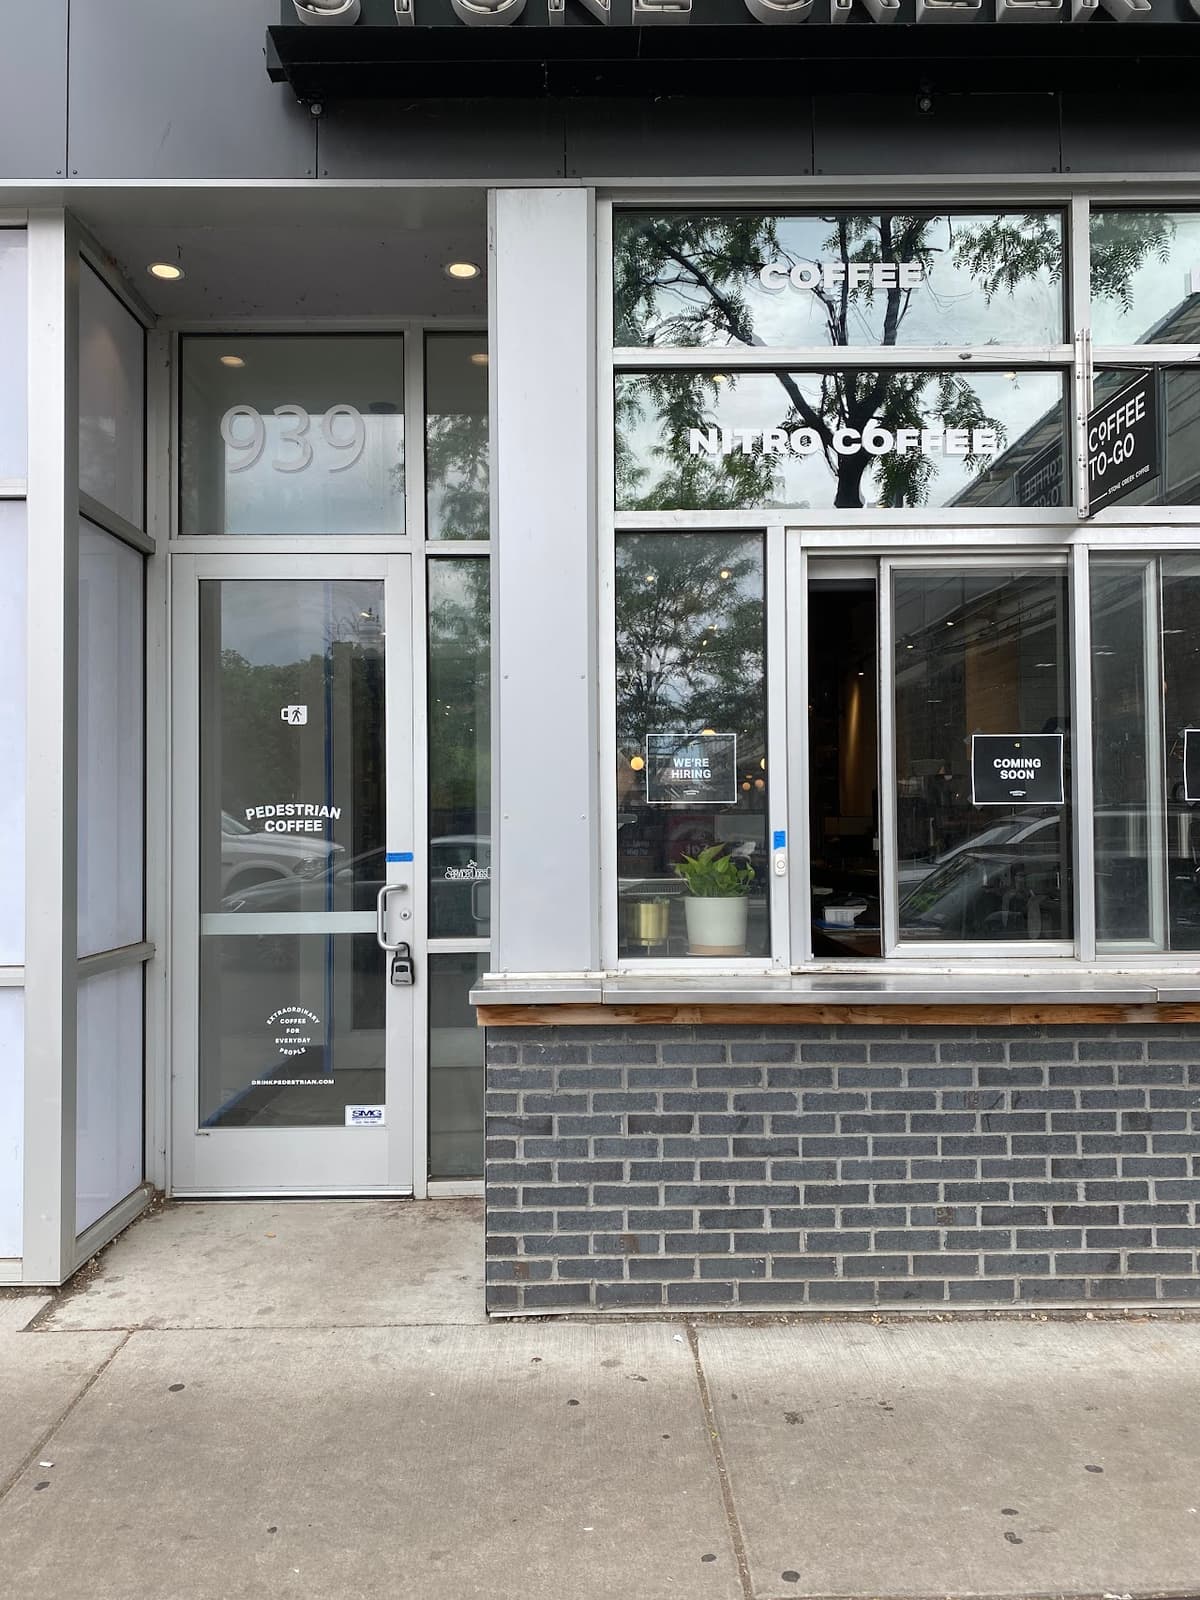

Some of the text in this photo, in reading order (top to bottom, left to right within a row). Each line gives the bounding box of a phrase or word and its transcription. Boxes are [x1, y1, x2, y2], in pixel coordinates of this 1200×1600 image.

[760, 262, 923, 289] COFFEE
[1088, 391, 1146, 452] COFFEE
[220, 404, 366, 473] 939
[689, 427, 998, 456] NITRO COFFEE
[1088, 432, 1135, 481] TO-GO
[673, 758, 709, 768] WE'RE
[993, 758, 1041, 769] COMING
[671, 769, 712, 779] HIRING
[1000, 769, 1035, 780] SOON
[245, 803, 341, 820] PEDESTRIAN
[264, 820, 323, 832] COFFEE
[266, 1006, 320, 1024] EXTRAORDINARY
[279, 1046, 306, 1056] PEOPLE
[352, 1109, 382, 1117] SMG
